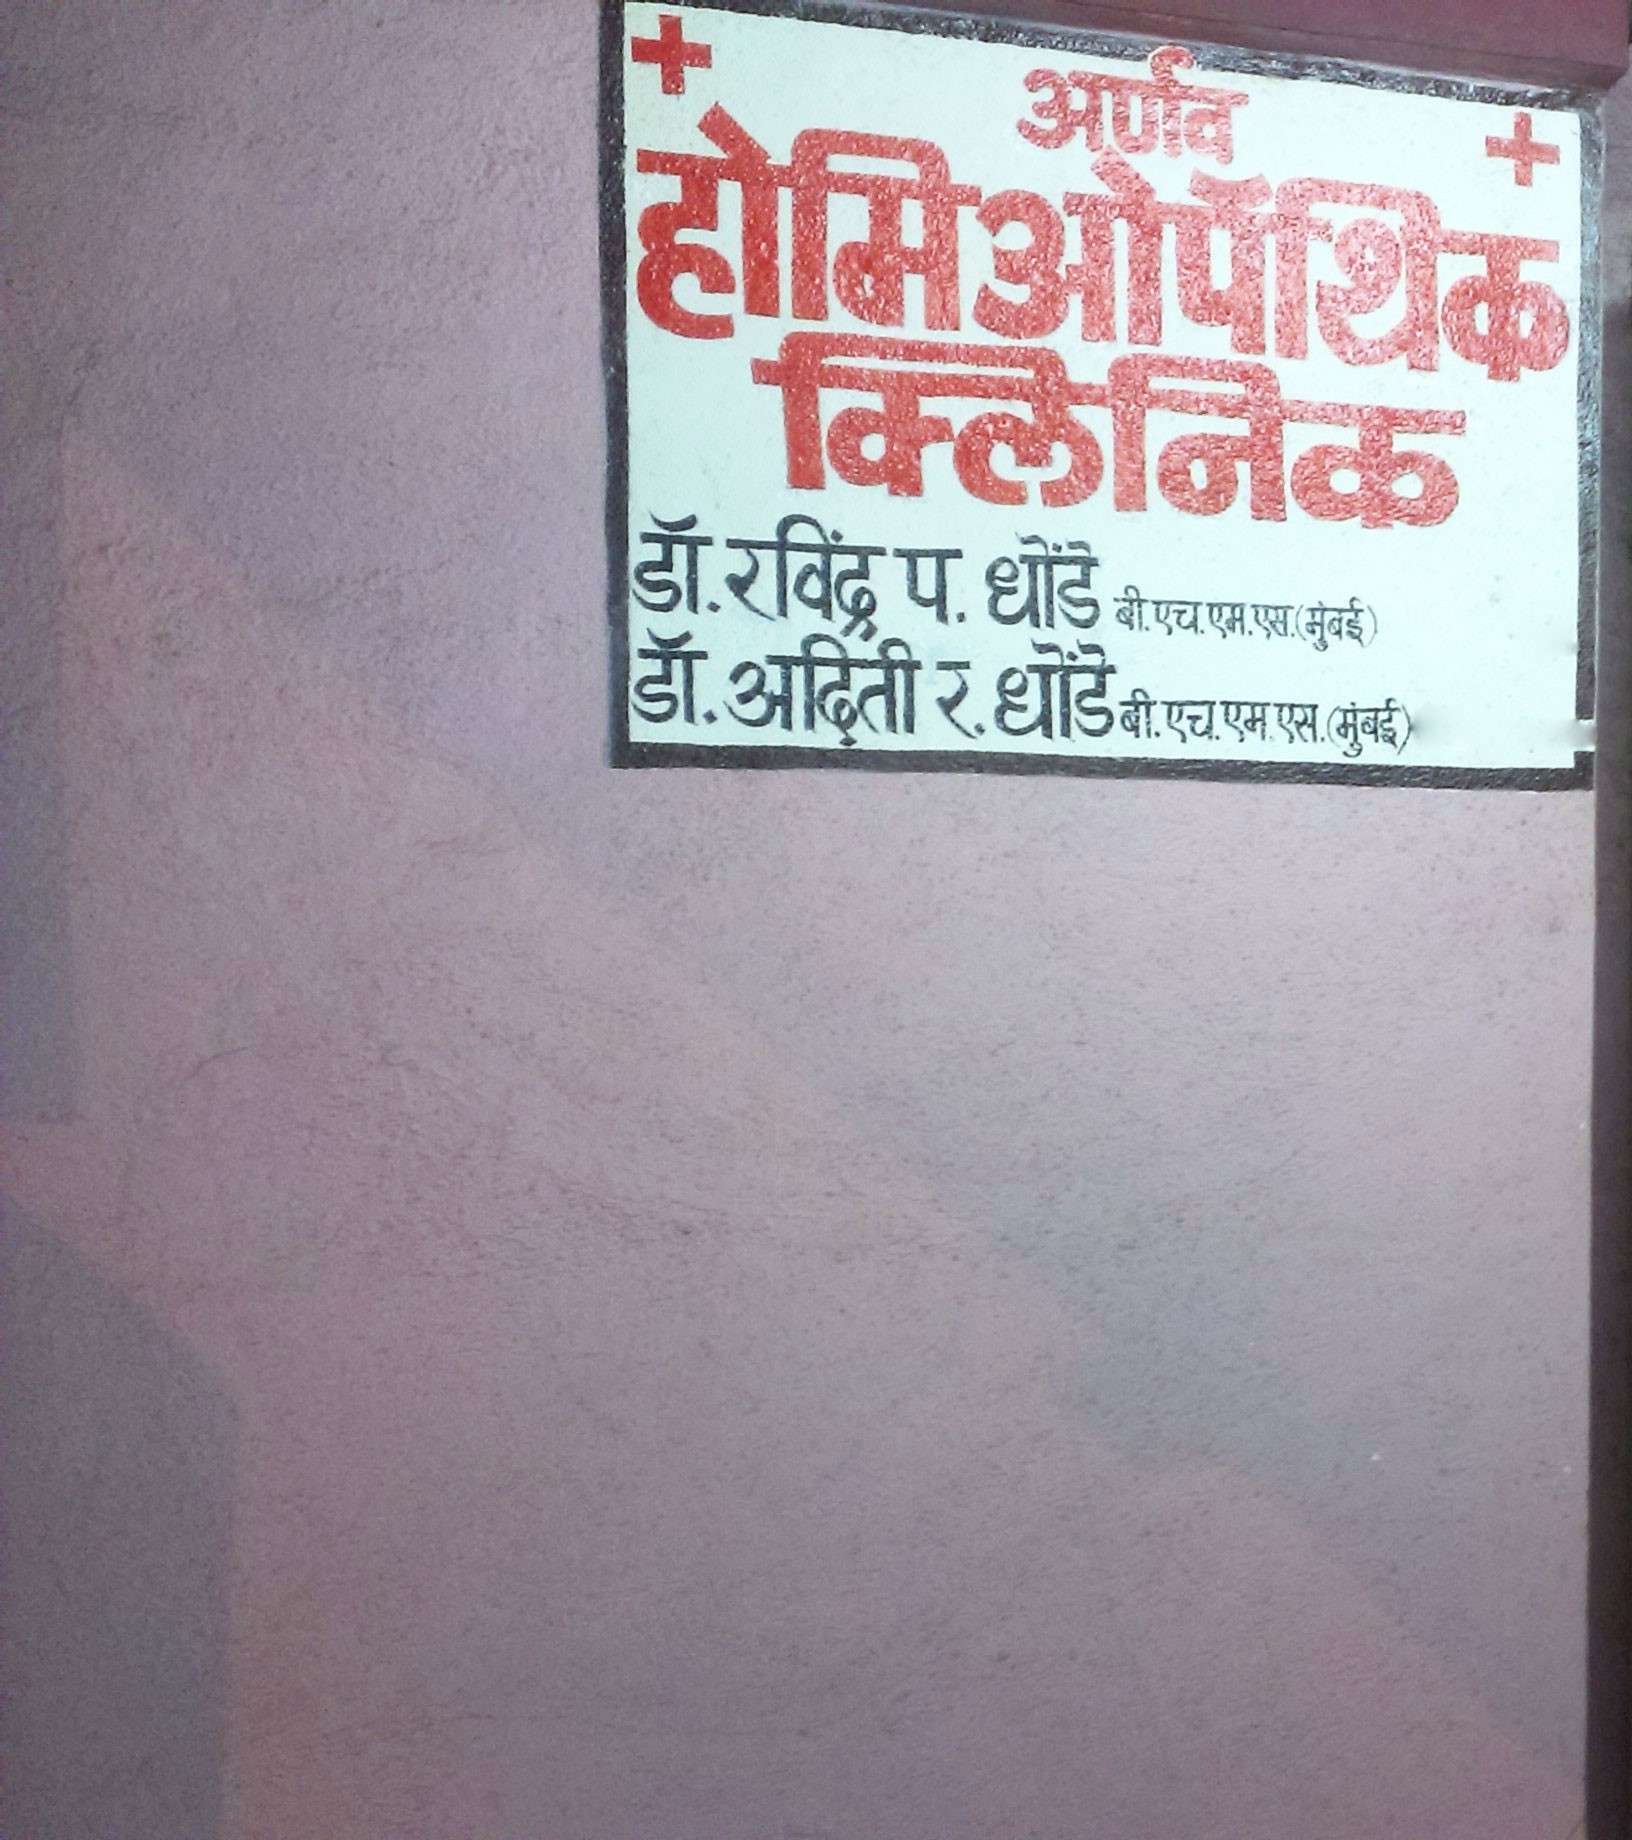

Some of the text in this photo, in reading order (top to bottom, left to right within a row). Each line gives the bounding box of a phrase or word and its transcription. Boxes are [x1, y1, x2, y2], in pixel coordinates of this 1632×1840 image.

[1017, 46, 1250, 164] अर्णव
[635, 101, 1570, 382] होमिओपॅथिक
[752, 331, 1467, 528] क्लिनिक
[632, 513, 720, 615] डॉ.
[725, 514, 888, 642] रविंद्र
[893, 547, 966, 625] प.
[984, 531, 1102, 630] धोंडे
[632, 627, 718, 725] डॉ.
[722, 633, 922, 747] अदिती
[935, 660, 986, 739] र.
[993, 639, 1117, 741] धोंडे
